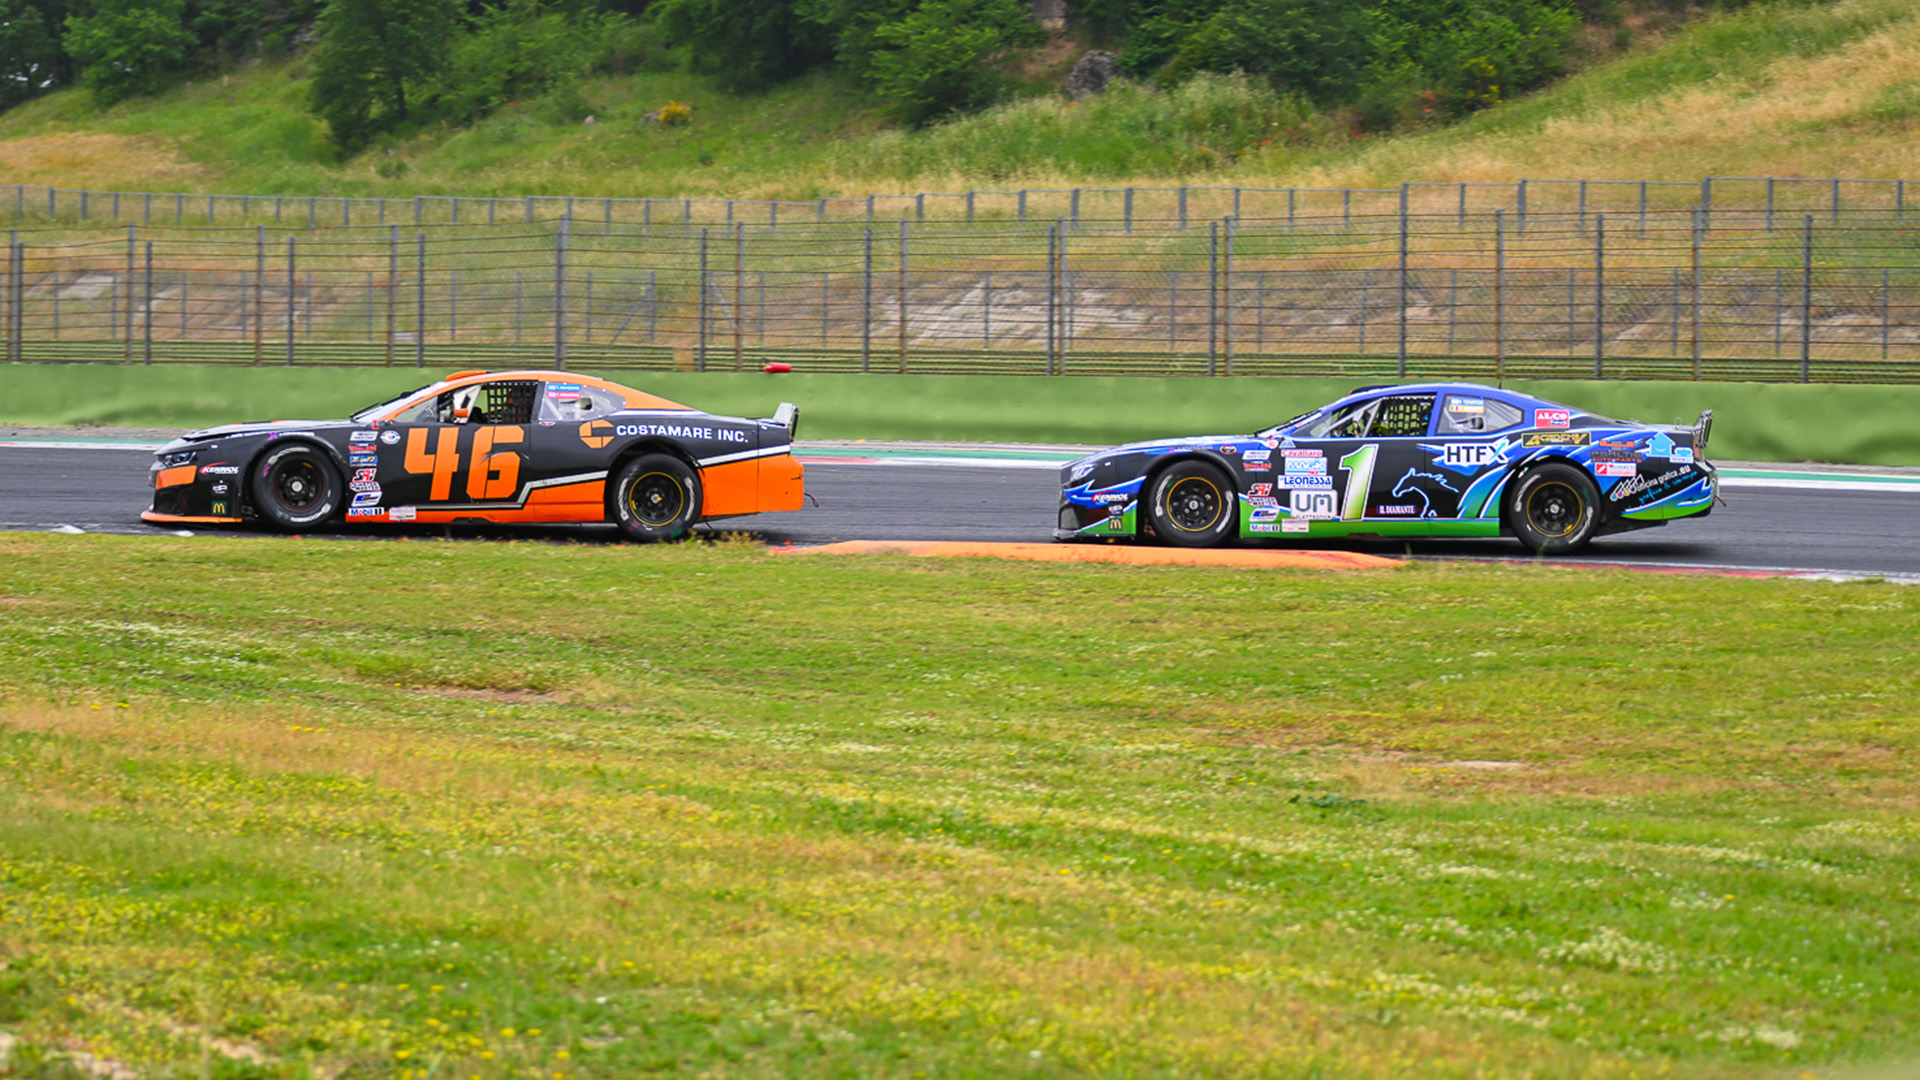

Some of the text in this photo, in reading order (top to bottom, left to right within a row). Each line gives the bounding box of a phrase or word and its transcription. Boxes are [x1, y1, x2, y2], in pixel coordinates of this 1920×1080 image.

[1537, 412, 1568, 420] ALCO
[616, 424, 748, 442] COSTAMARE INC.
[1282, 449, 1323, 457] Cavallaro
[1446, 442, 1508, 463] HTFX
[403, 425, 525, 501] 46
[202, 466, 239, 474] KENNOL
[1284, 476, 1331, 485] LEONESSA
[1338, 443, 1379, 522] 1
[1093, 493, 1129, 502] KENNOL
[1295, 493, 1332, 513] UM
[350, 508, 373, 516] Mobil
[1386, 505, 1415, 514] DIAMANTE
